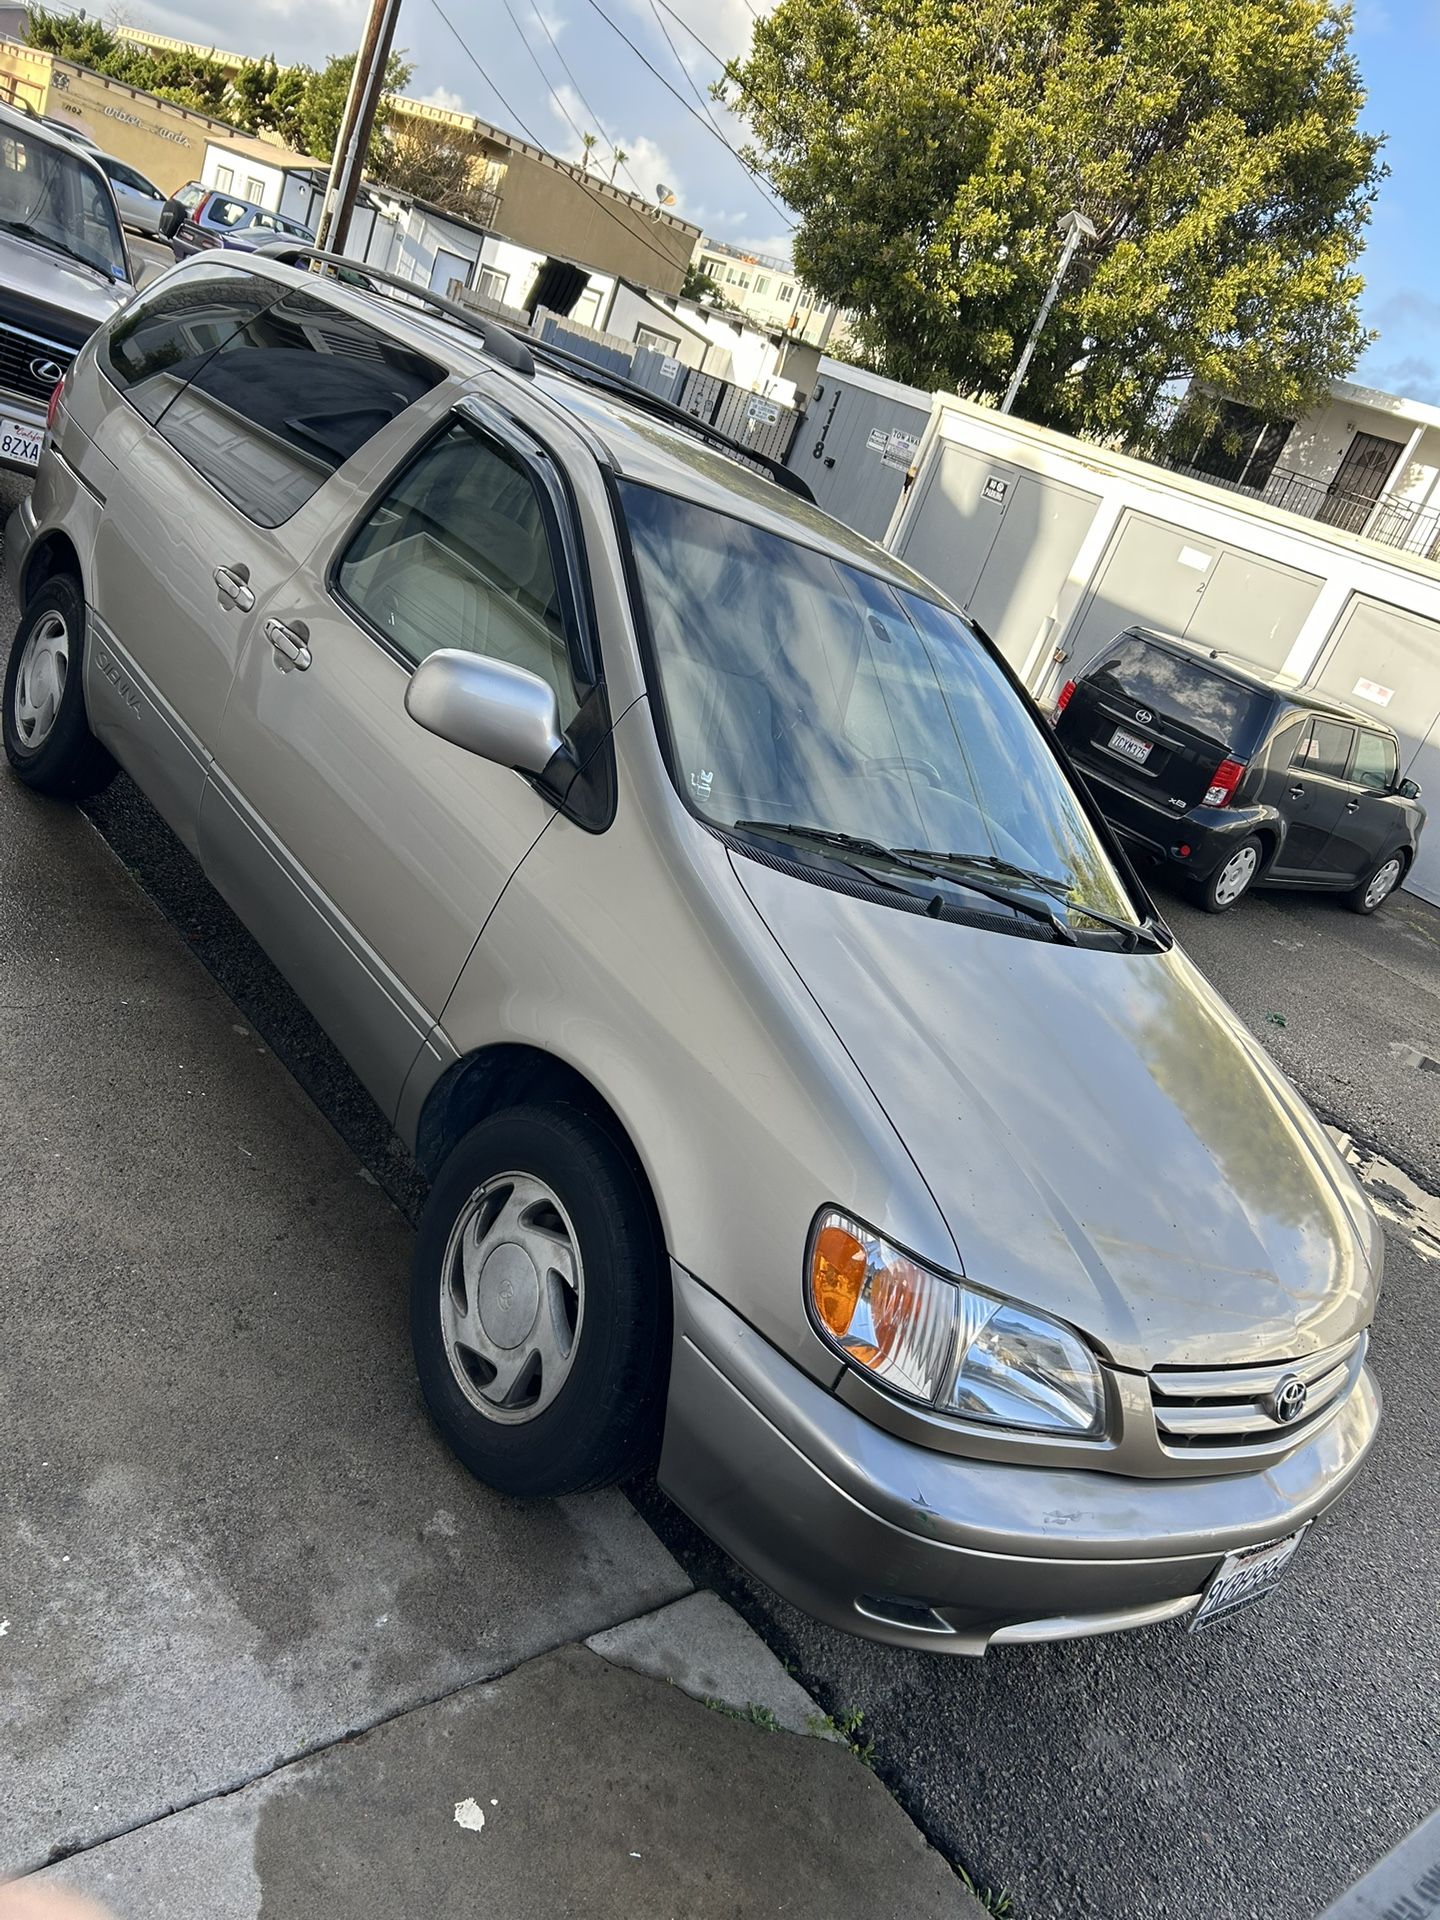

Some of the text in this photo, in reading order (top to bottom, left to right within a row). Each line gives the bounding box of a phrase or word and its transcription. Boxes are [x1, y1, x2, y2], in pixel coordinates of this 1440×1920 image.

[813, 390, 842, 459] 1118
[2, 435, 39, 460] 8ZXA
[1196, 582, 1206, 593] 2
[96, 652, 141, 720] SIENNA
[1168, 797, 1187, 809] xB
